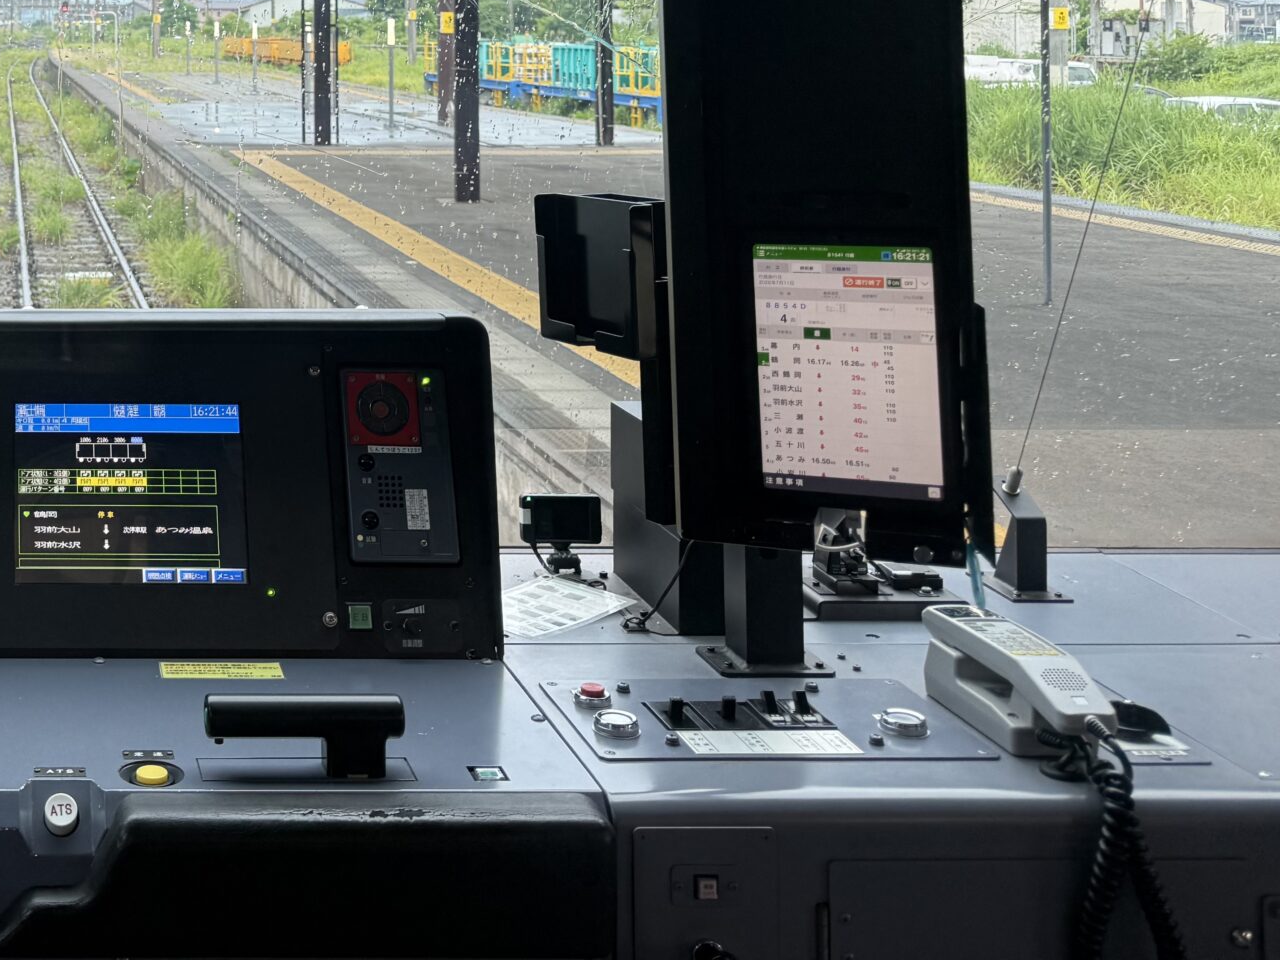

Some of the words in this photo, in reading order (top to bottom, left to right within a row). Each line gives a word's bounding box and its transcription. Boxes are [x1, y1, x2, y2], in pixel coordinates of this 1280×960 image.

[892, 252, 930, 261] 16:21:21
[772, 384, 803, 393] 羽前大山
[773, 398, 803, 407] 羽前水沢
[192, 405, 238, 417] 16:21:44
[775, 440, 805, 449] 五十川
[775, 454, 806, 463] あつみ
[765, 476, 804, 487] 注意事項
[33, 525, 81, 534] 羽前大山
[155, 526, 214, 534] あつみ温泉
[33, 540, 82, 549] 羽前水沢
[218, 572, 241, 580] メニュー
[50, 803, 73, 817] ATS
